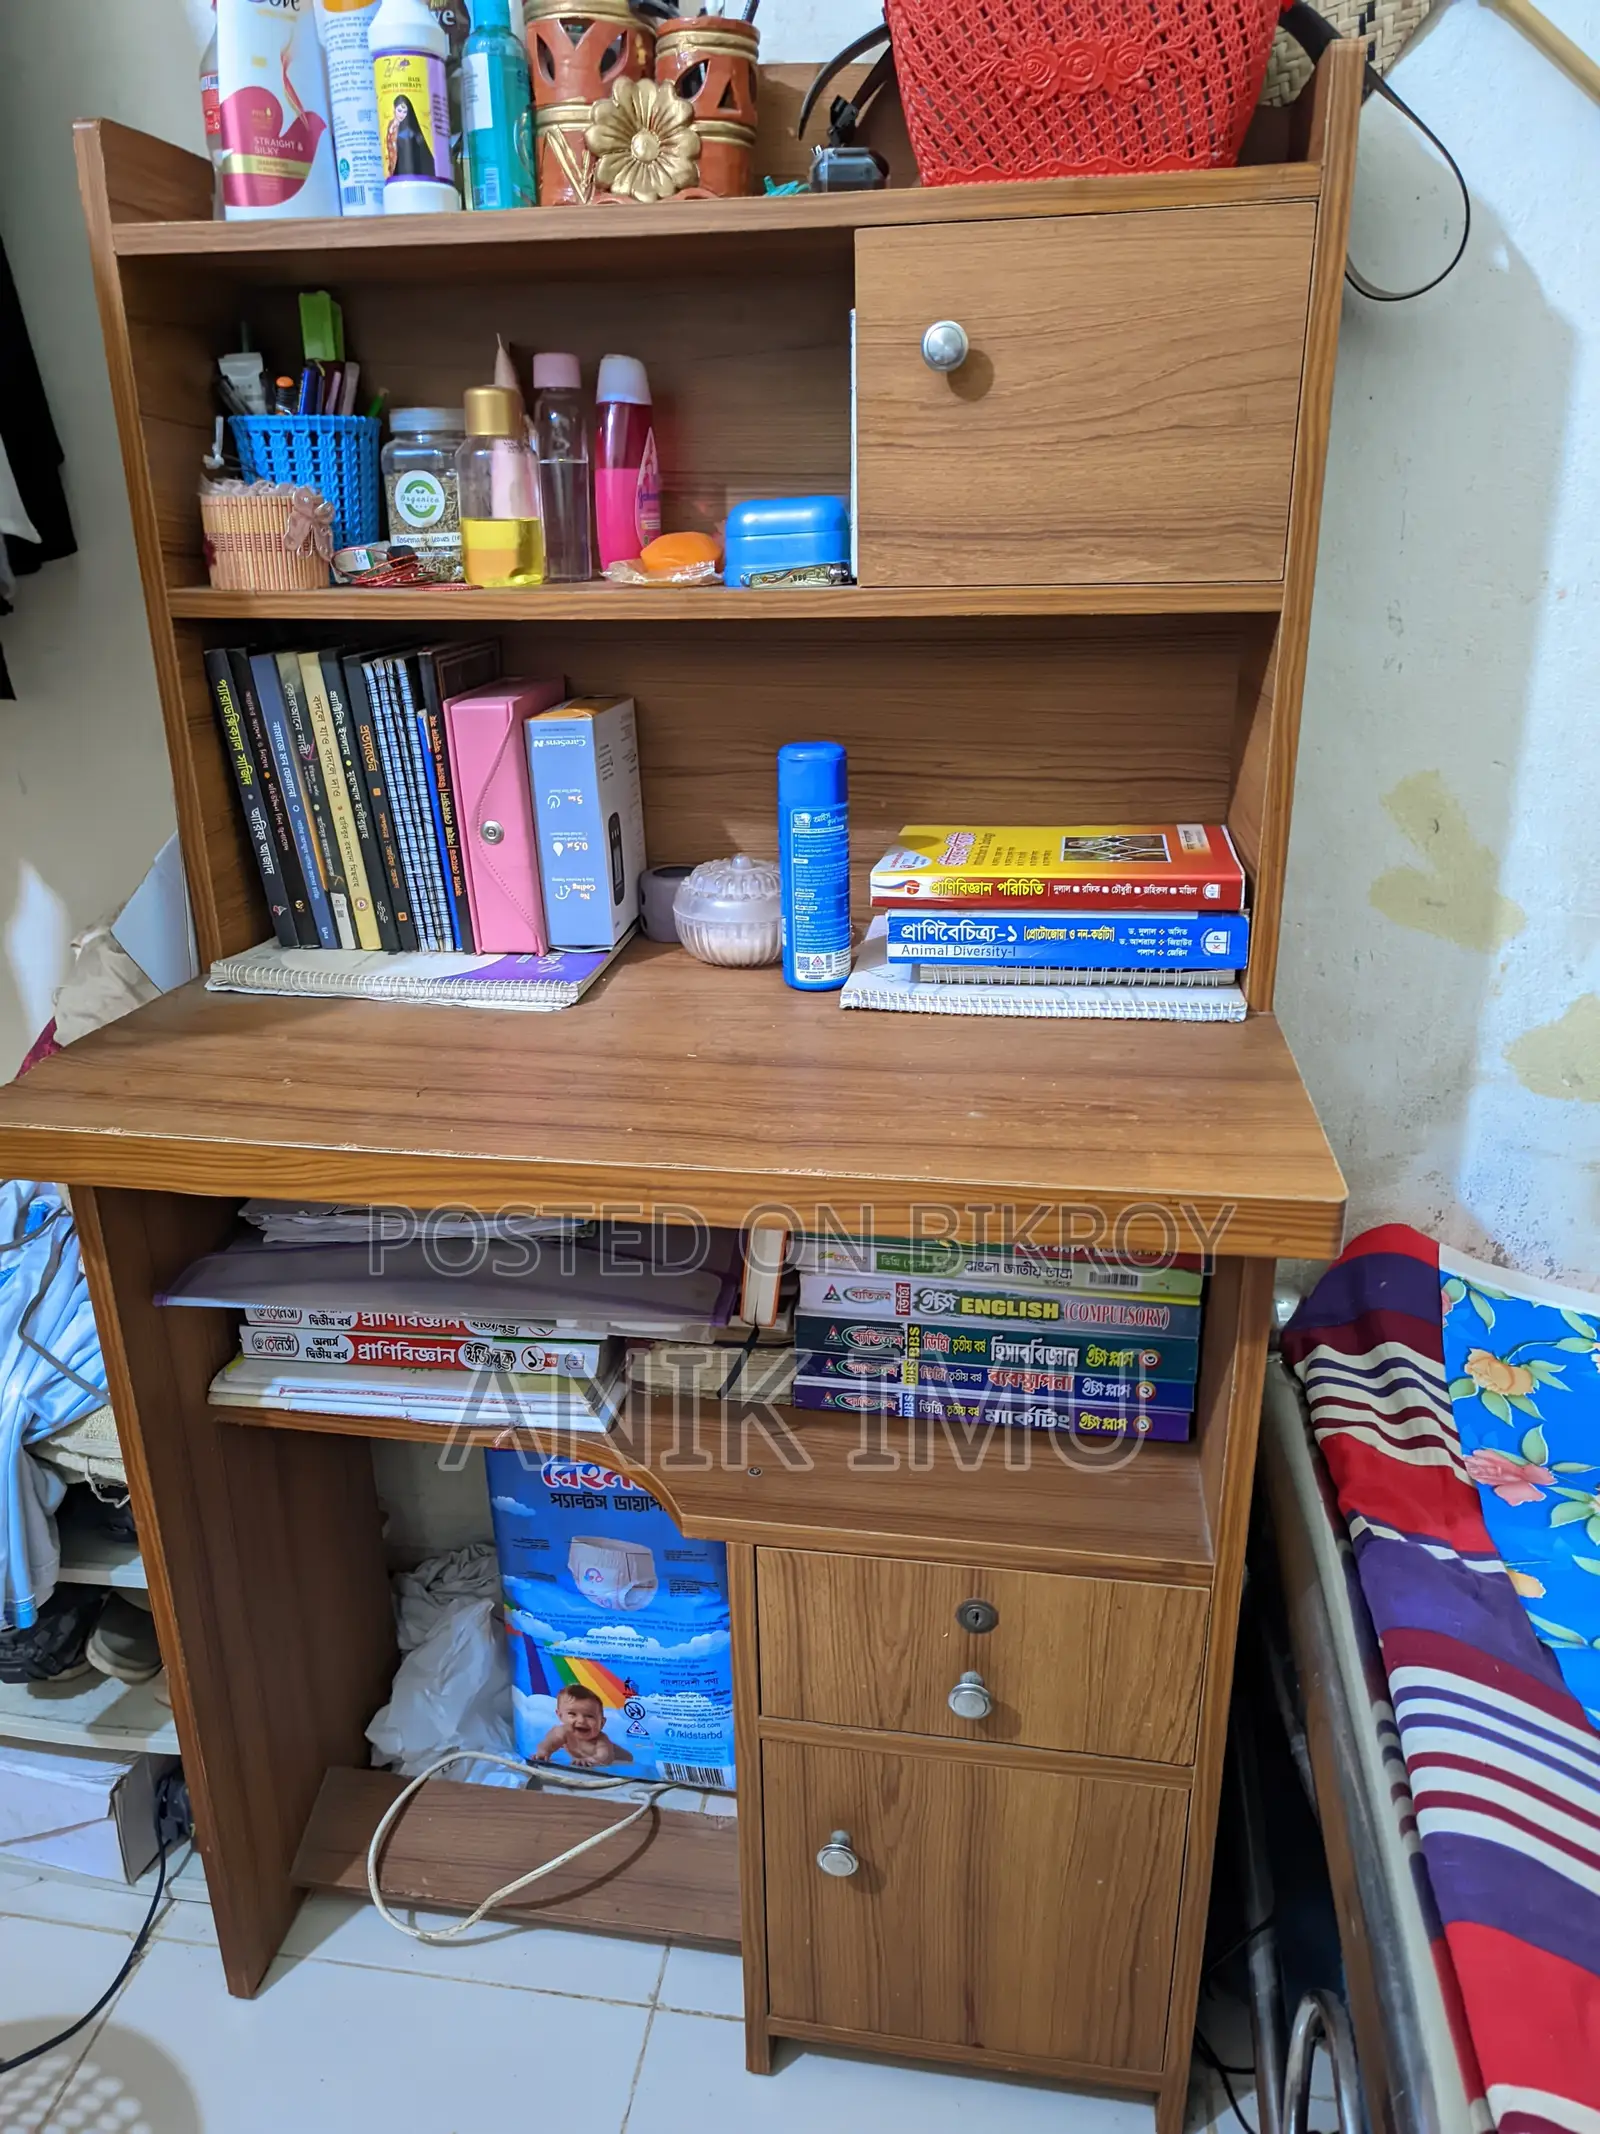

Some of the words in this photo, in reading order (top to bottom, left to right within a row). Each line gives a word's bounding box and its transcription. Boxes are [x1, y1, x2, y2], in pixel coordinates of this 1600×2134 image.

[254, 136, 295, 150] STRAIGHT
[254, 146, 279, 155] SILKY
[298, 732, 312, 754] নারী
[312, 694, 326, 722] বদলে
[324, 748, 336, 776] বদলে
[338, 726, 350, 756] ইসলাম
[548, 739, 586, 747] CareSens
[216, 678, 244, 750] প্যারাডক্সিক্যাল
[236, 754, 252, 786] সাজিদ
[250, 806, 266, 840] আরিফ
[260, 842, 274, 874] আজাদ
[577, 796, 583, 804] 5
[575, 842, 588, 851] 0.5
[572, 883, 596, 891] Coding
[930, 878, 993, 896] প্রাণিবিজ্ঞান
[997, 878, 1045, 896] পরিচিতি
[1053, 884, 1071, 895] দুলাল
[1082, 885, 1101, 894] রফিক
[1111, 883, 1132, 895] চৌধুরী
[901, 919, 1018, 942] প্রাণিবৈচিত্র্য-১
[1138, 927, 1156, 936] দুলাল
[901, 945, 948, 956] Animal
[953, 945, 1016, 959] Diversity-I
[964, 1260, 999, 1272] বাংলা
[1004, 1259, 1041, 1279] জাতীয়
[897, 1286, 910, 1313] ডিগ্রি
[308, 1314, 335, 1326] দ্বিতীয়
[336, 1316, 352, 1327] বর্ষ
[961, 1297, 1060, 1320] ENGLISH
[1064, 1301, 1171, 1330] (COMPULSORY)
[312, 1335, 340, 1346] অনার্স
[851, 1330, 904, 1348] ব্যতিক্রম
[908, 1327, 920, 1358] BBS
[305, 1348, 333, 1359] দ্বিতীয়
[334, 1349, 348, 1360] বর্ষ
[357, 1340, 456, 1363] প্রাণিবিজ্ঞান
[923, 1332, 951, 1353] ডিগ্রি
[952, 1335, 972, 1354] তৃতীয়
[974, 1340, 986, 1353] বর্ষ
[990, 1335, 1079, 1368] হিসাববিজ্ঞান
[905, 1361, 917, 1384] BBS
[920, 1366, 947, 1382] ডিগ্রি
[970, 1372, 982, 1383] বর্ষ
[987, 1369, 1074, 1393] ব্যবস্থাপনা
[903, 1394, 915, 1417] BBS
[919, 1402, 943, 1416] ডিগ্রি
[946, 1403, 966, 1417] তৃতীয়
[967, 1406, 980, 1416] বর্ষ
[985, 1406, 1070, 1430] মার্কেটিং
[613, 1495, 667, 1512] ডায়াপ
[676, 1731, 723, 1740] /kidstarbd
